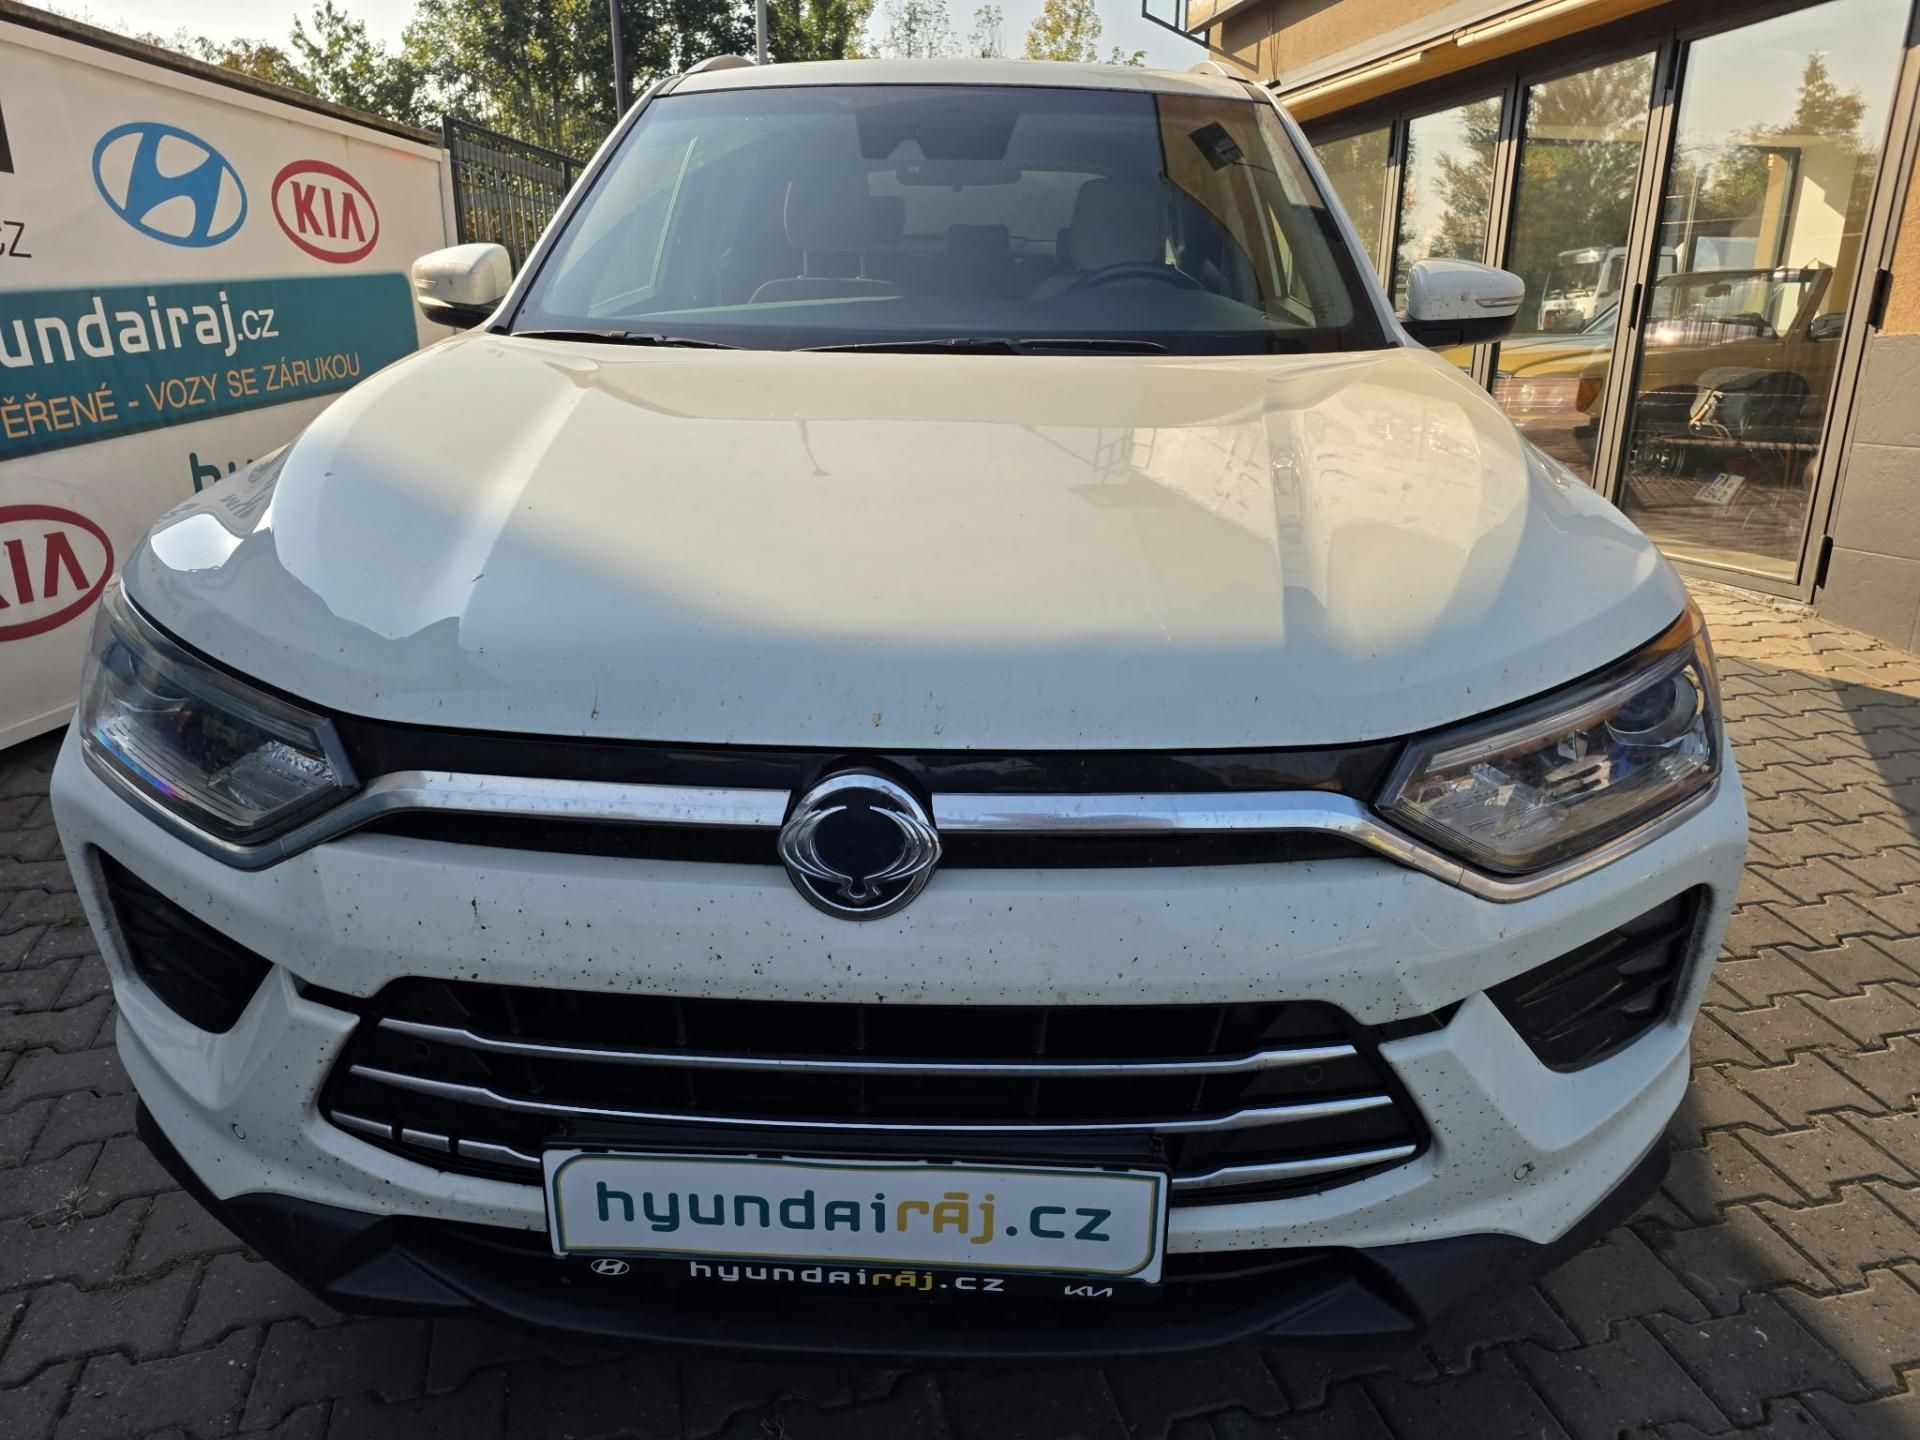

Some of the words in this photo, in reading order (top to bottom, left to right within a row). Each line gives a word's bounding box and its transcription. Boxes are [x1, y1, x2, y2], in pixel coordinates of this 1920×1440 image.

[0, 220, 32, 258] Z
[290, 181, 366, 242] KIA
[146, 373, 217, 411] VOZY
[227, 368, 259, 397] SE
[263, 352, 360, 391] ZÁRUKOU
[0, 532, 90, 609] IA
